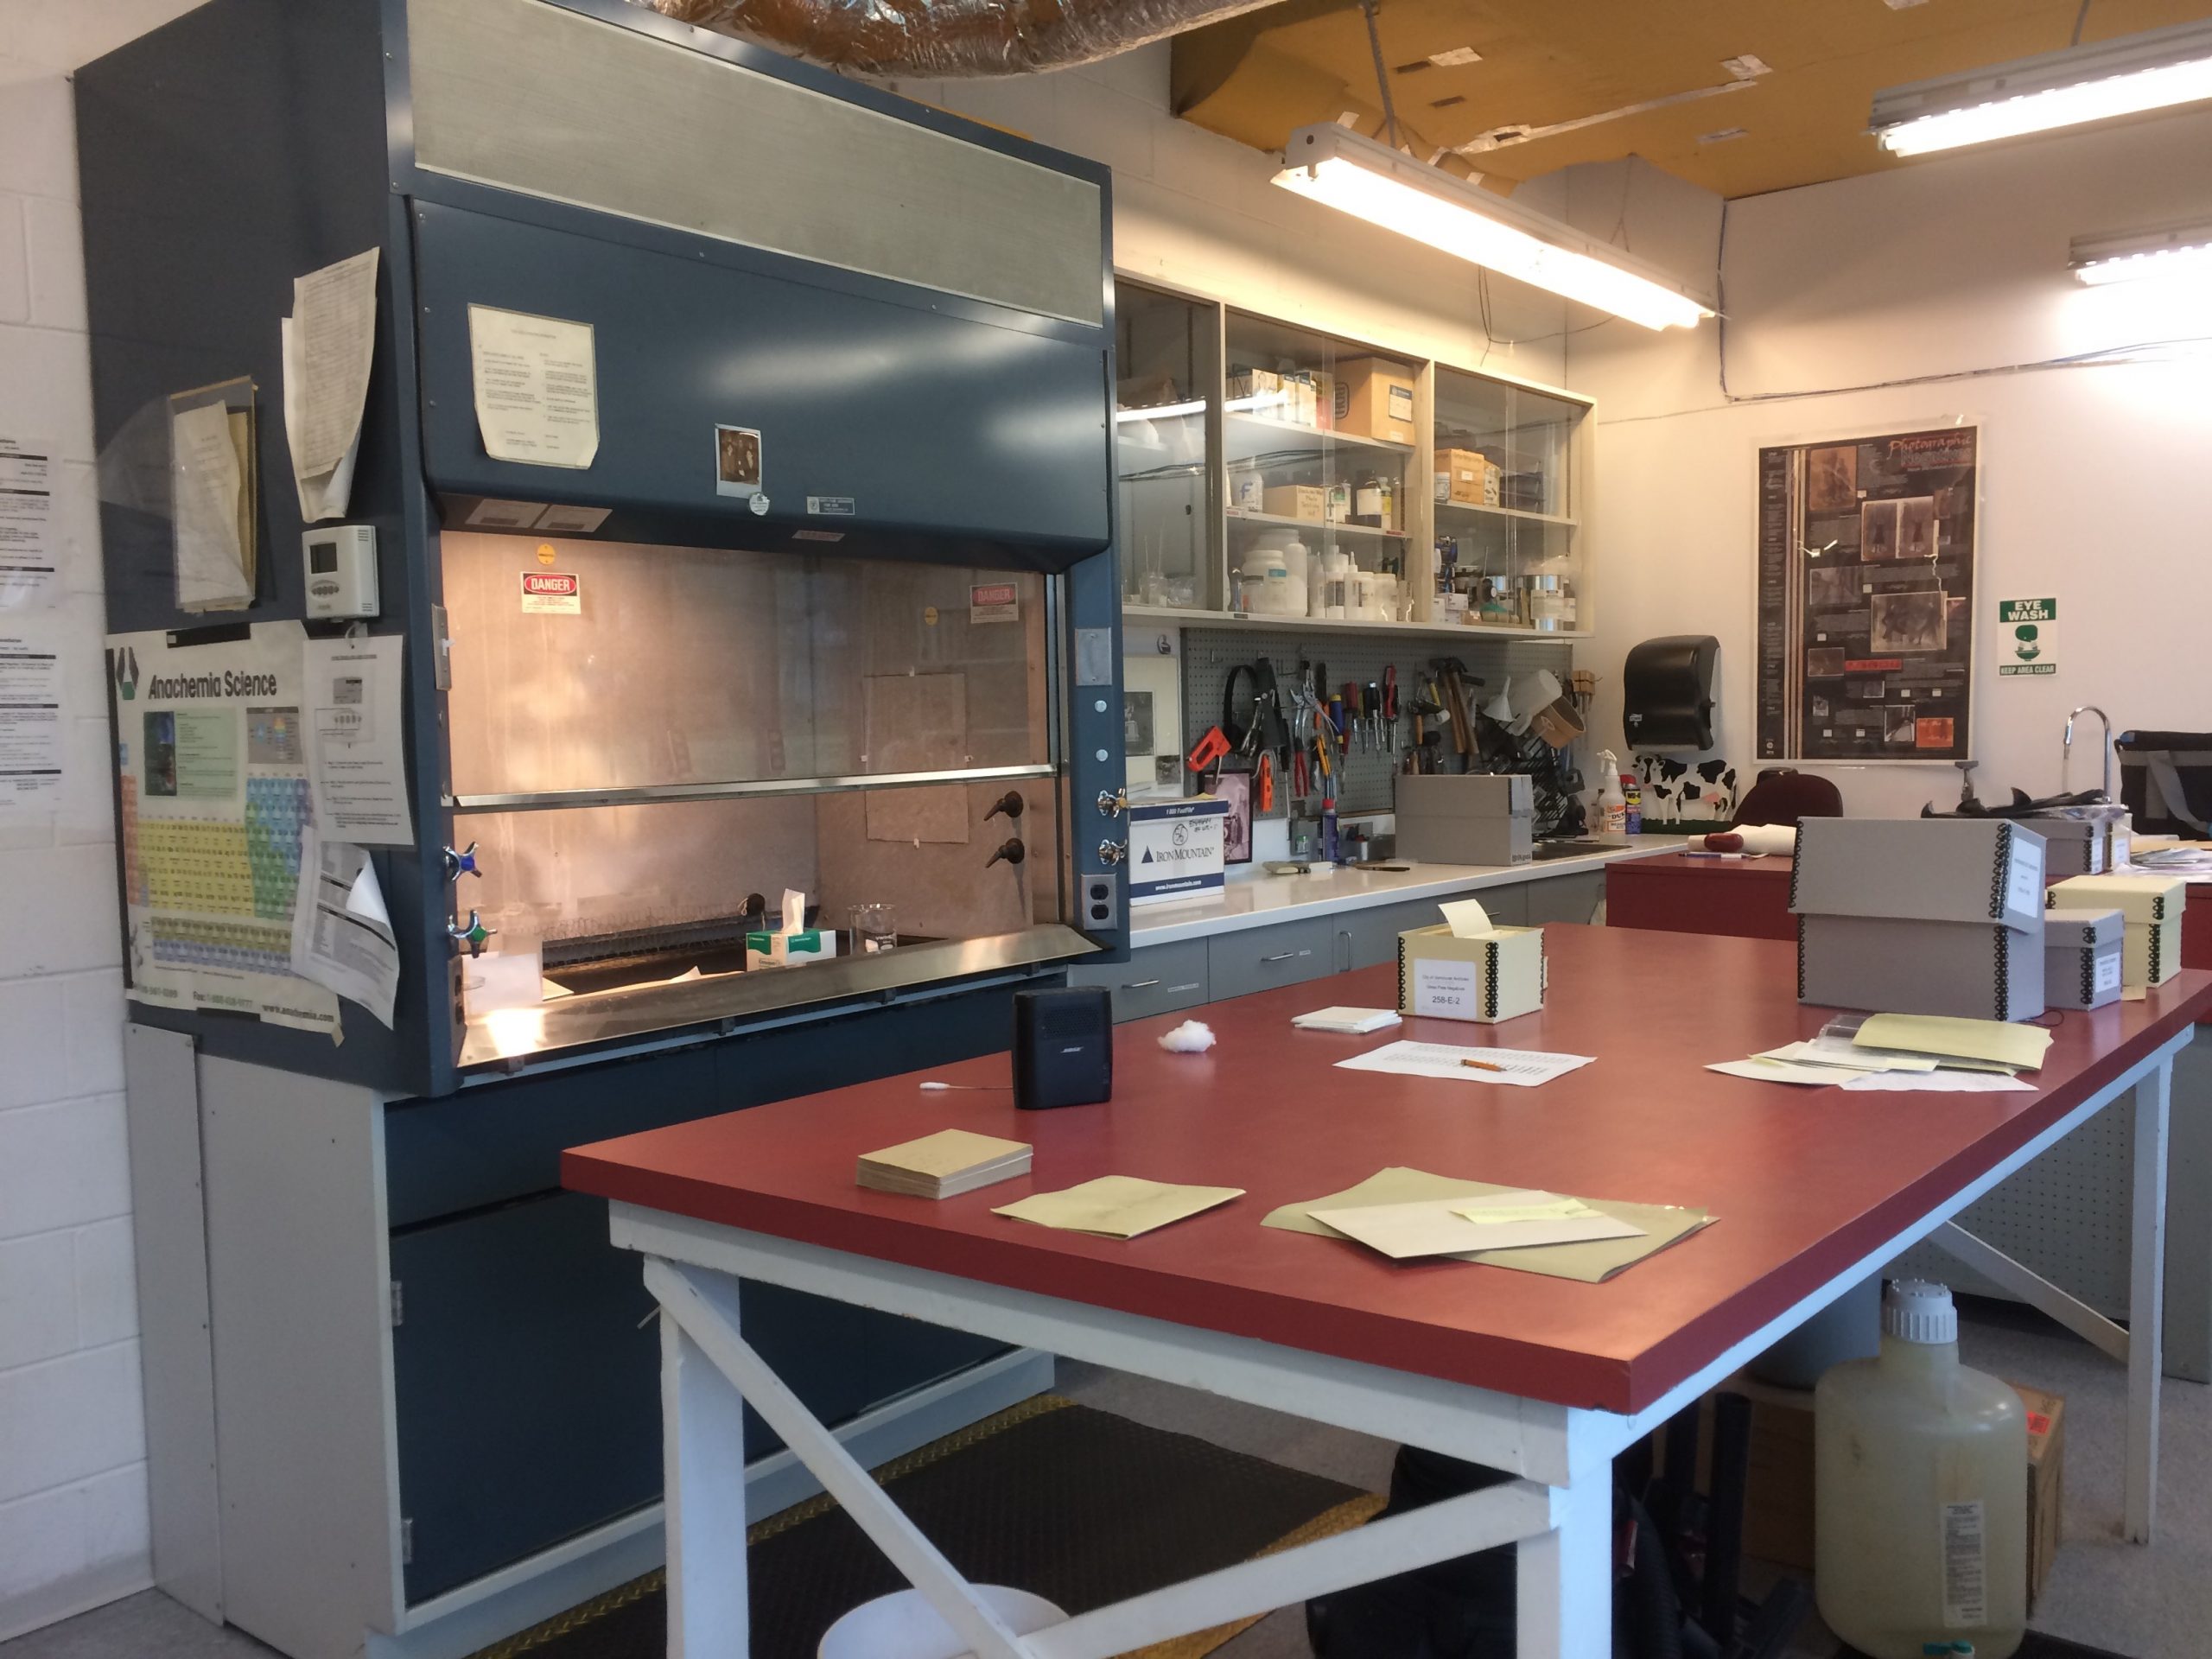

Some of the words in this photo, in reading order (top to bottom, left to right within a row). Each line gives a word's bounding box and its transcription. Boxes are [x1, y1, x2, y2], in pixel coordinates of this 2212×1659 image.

[1886, 432, 1972, 461] Photographic
[531, 578, 570, 591] DANGER
[977, 588, 1010, 602] DANGER
[2015, 600, 2042, 611] EYE
[2007, 609, 2049, 621] WASH
[148, 672, 221, 699] Anachemia
[224, 671, 277, 696] Science
[1156, 850, 1174, 862] IRON
[1174, 848, 1212, 861] MOUNTAIN
[1432, 995, 1460, 1005] 258-E-2
